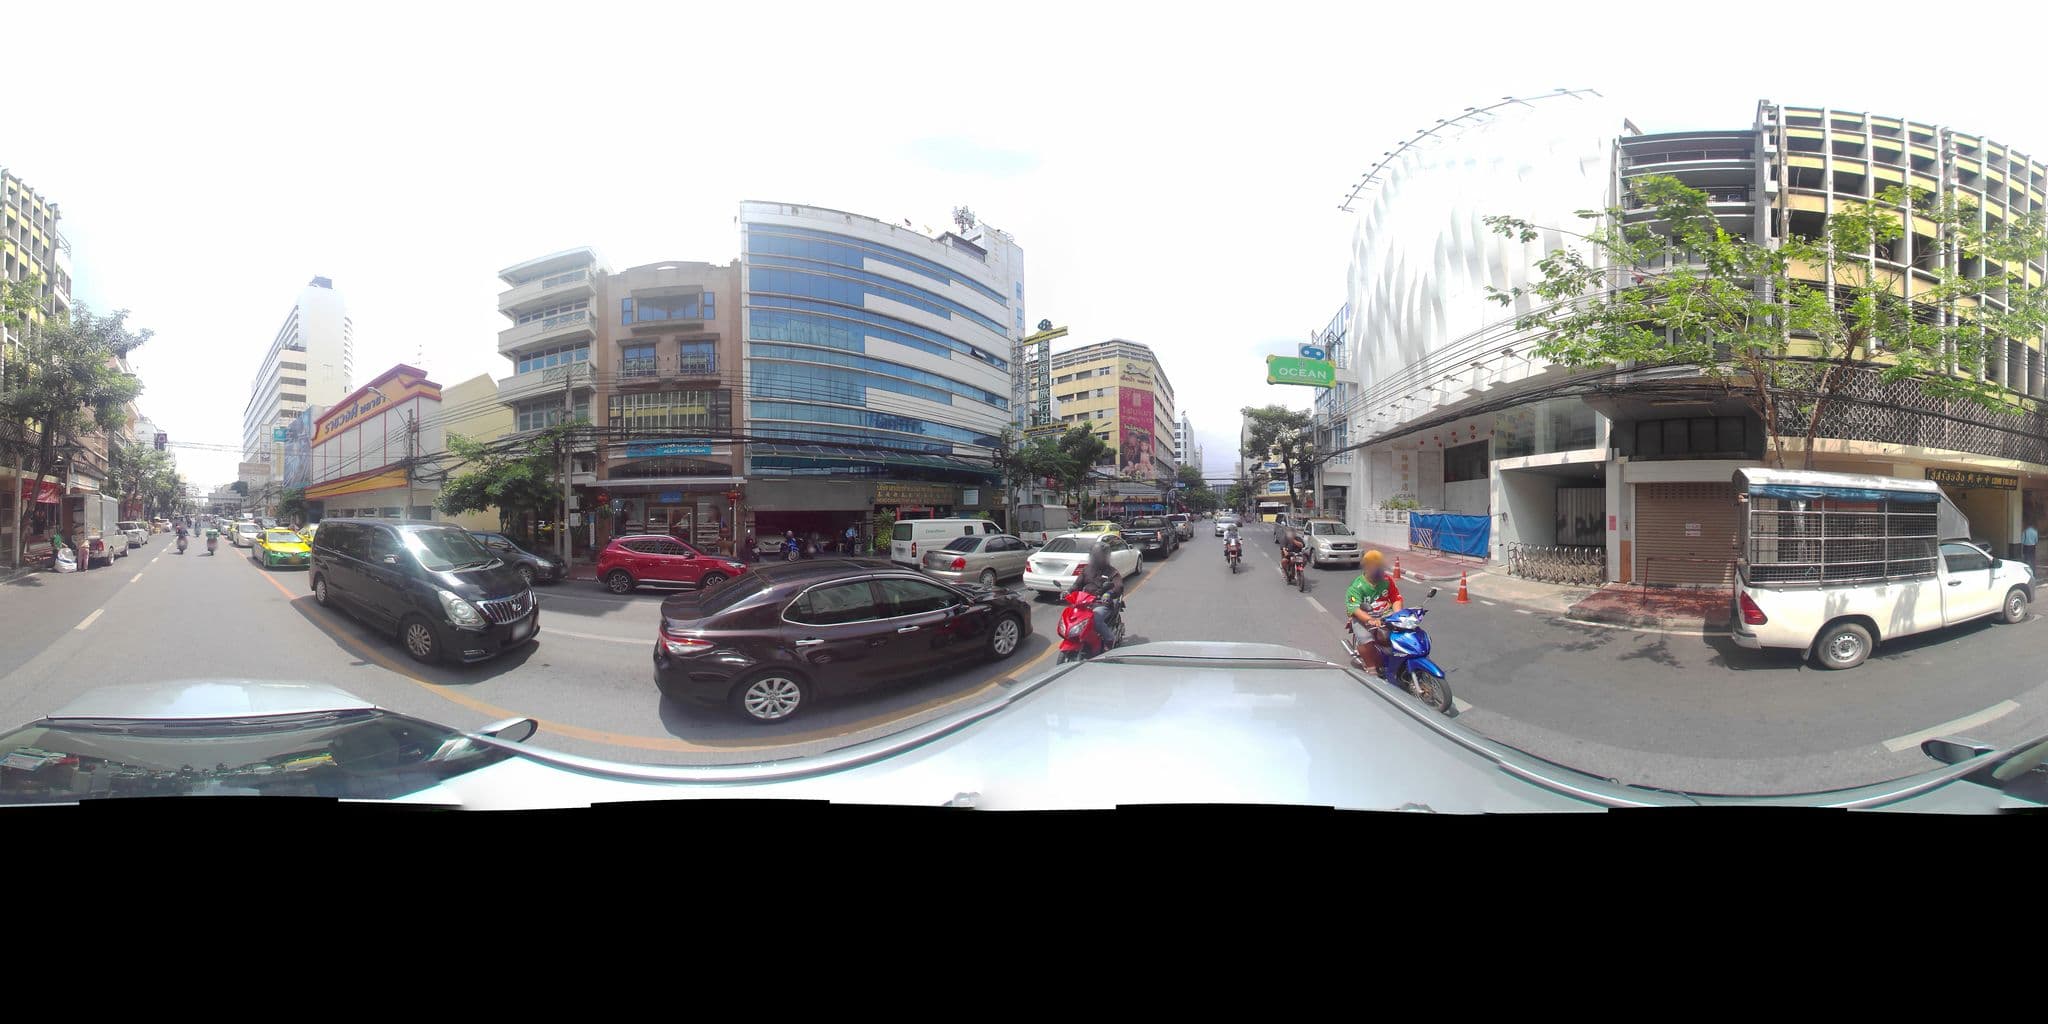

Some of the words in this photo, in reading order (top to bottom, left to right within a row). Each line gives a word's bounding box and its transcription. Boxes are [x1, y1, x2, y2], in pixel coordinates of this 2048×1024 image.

[1279, 367, 1327, 379] OCEAN
[324, 400, 358, 433] ราชวงศ์
[360, 396, 387, 415] พลาซ่า
